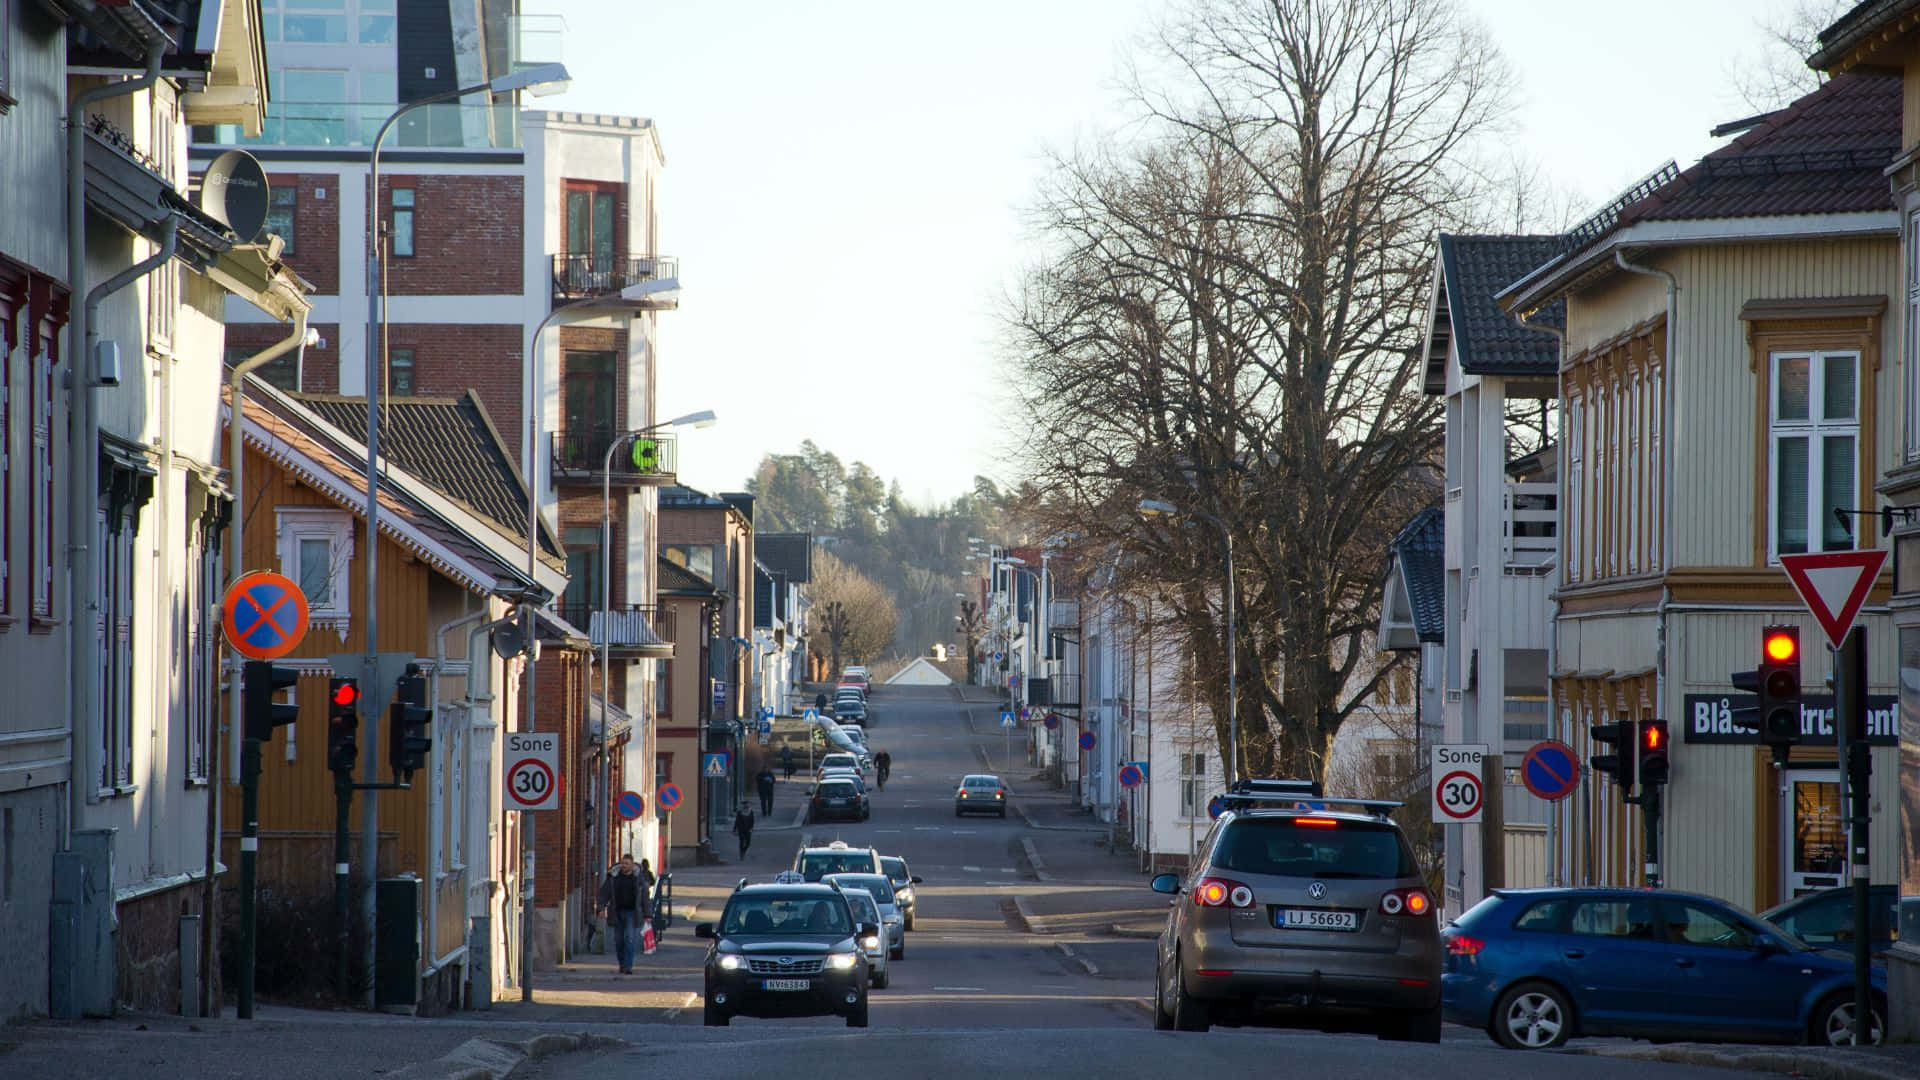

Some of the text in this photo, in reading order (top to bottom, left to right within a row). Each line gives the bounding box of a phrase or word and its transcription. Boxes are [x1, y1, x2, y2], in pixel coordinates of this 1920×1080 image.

[510, 736, 552, 751] Sone
[1438, 748, 1481, 763] Sone
[516, 770, 546, 793] 30
[1446, 782, 1476, 805] 30
[1289, 911, 1352, 927] LJ 56692
